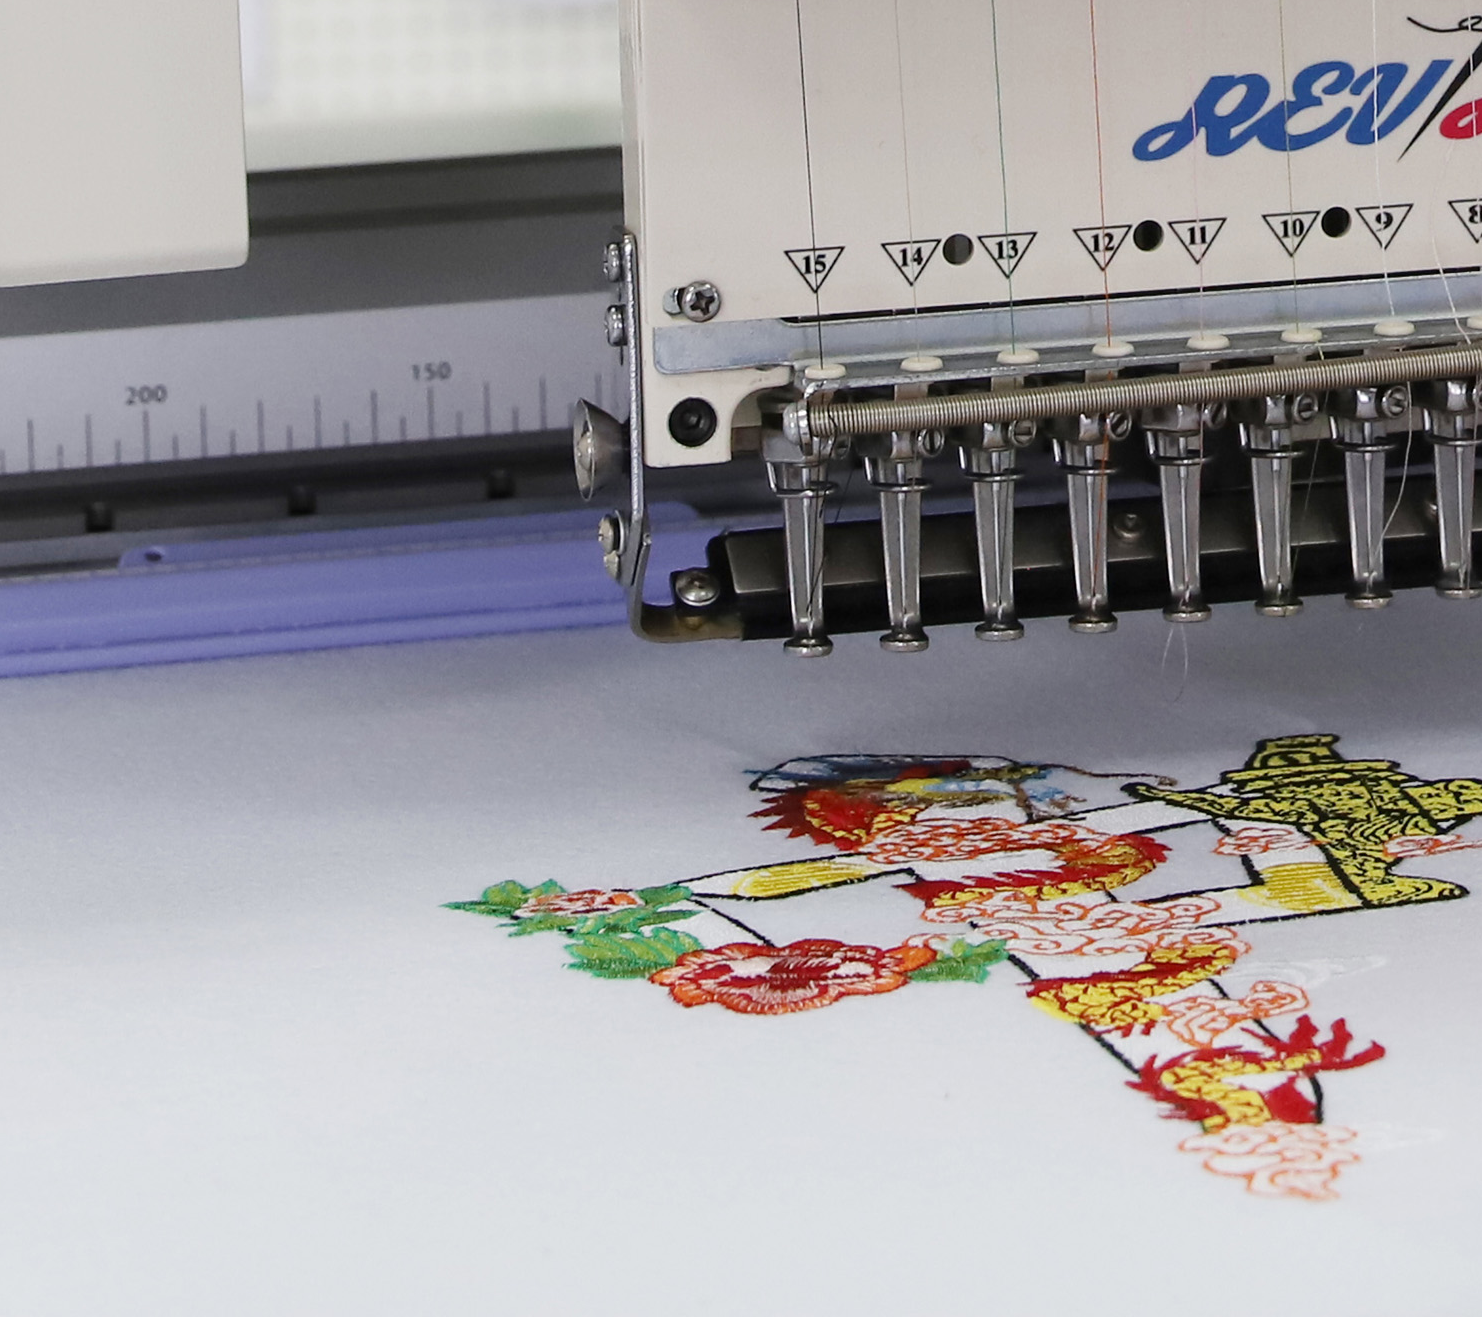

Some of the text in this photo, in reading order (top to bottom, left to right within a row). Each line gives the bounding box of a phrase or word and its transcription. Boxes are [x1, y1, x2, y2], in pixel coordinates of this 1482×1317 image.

[802, 253, 827, 275] 15
[898, 246, 924, 268] 14
[994, 239, 1019, 260] 13
[1090, 231, 1115, 253] 12
[1186, 224, 1209, 246] 11
[1279, 217, 1305, 239] 10
[1374, 211, 1394, 232] 9
[124, 383, 169, 406] 200
[412, 361, 453, 382] 150
